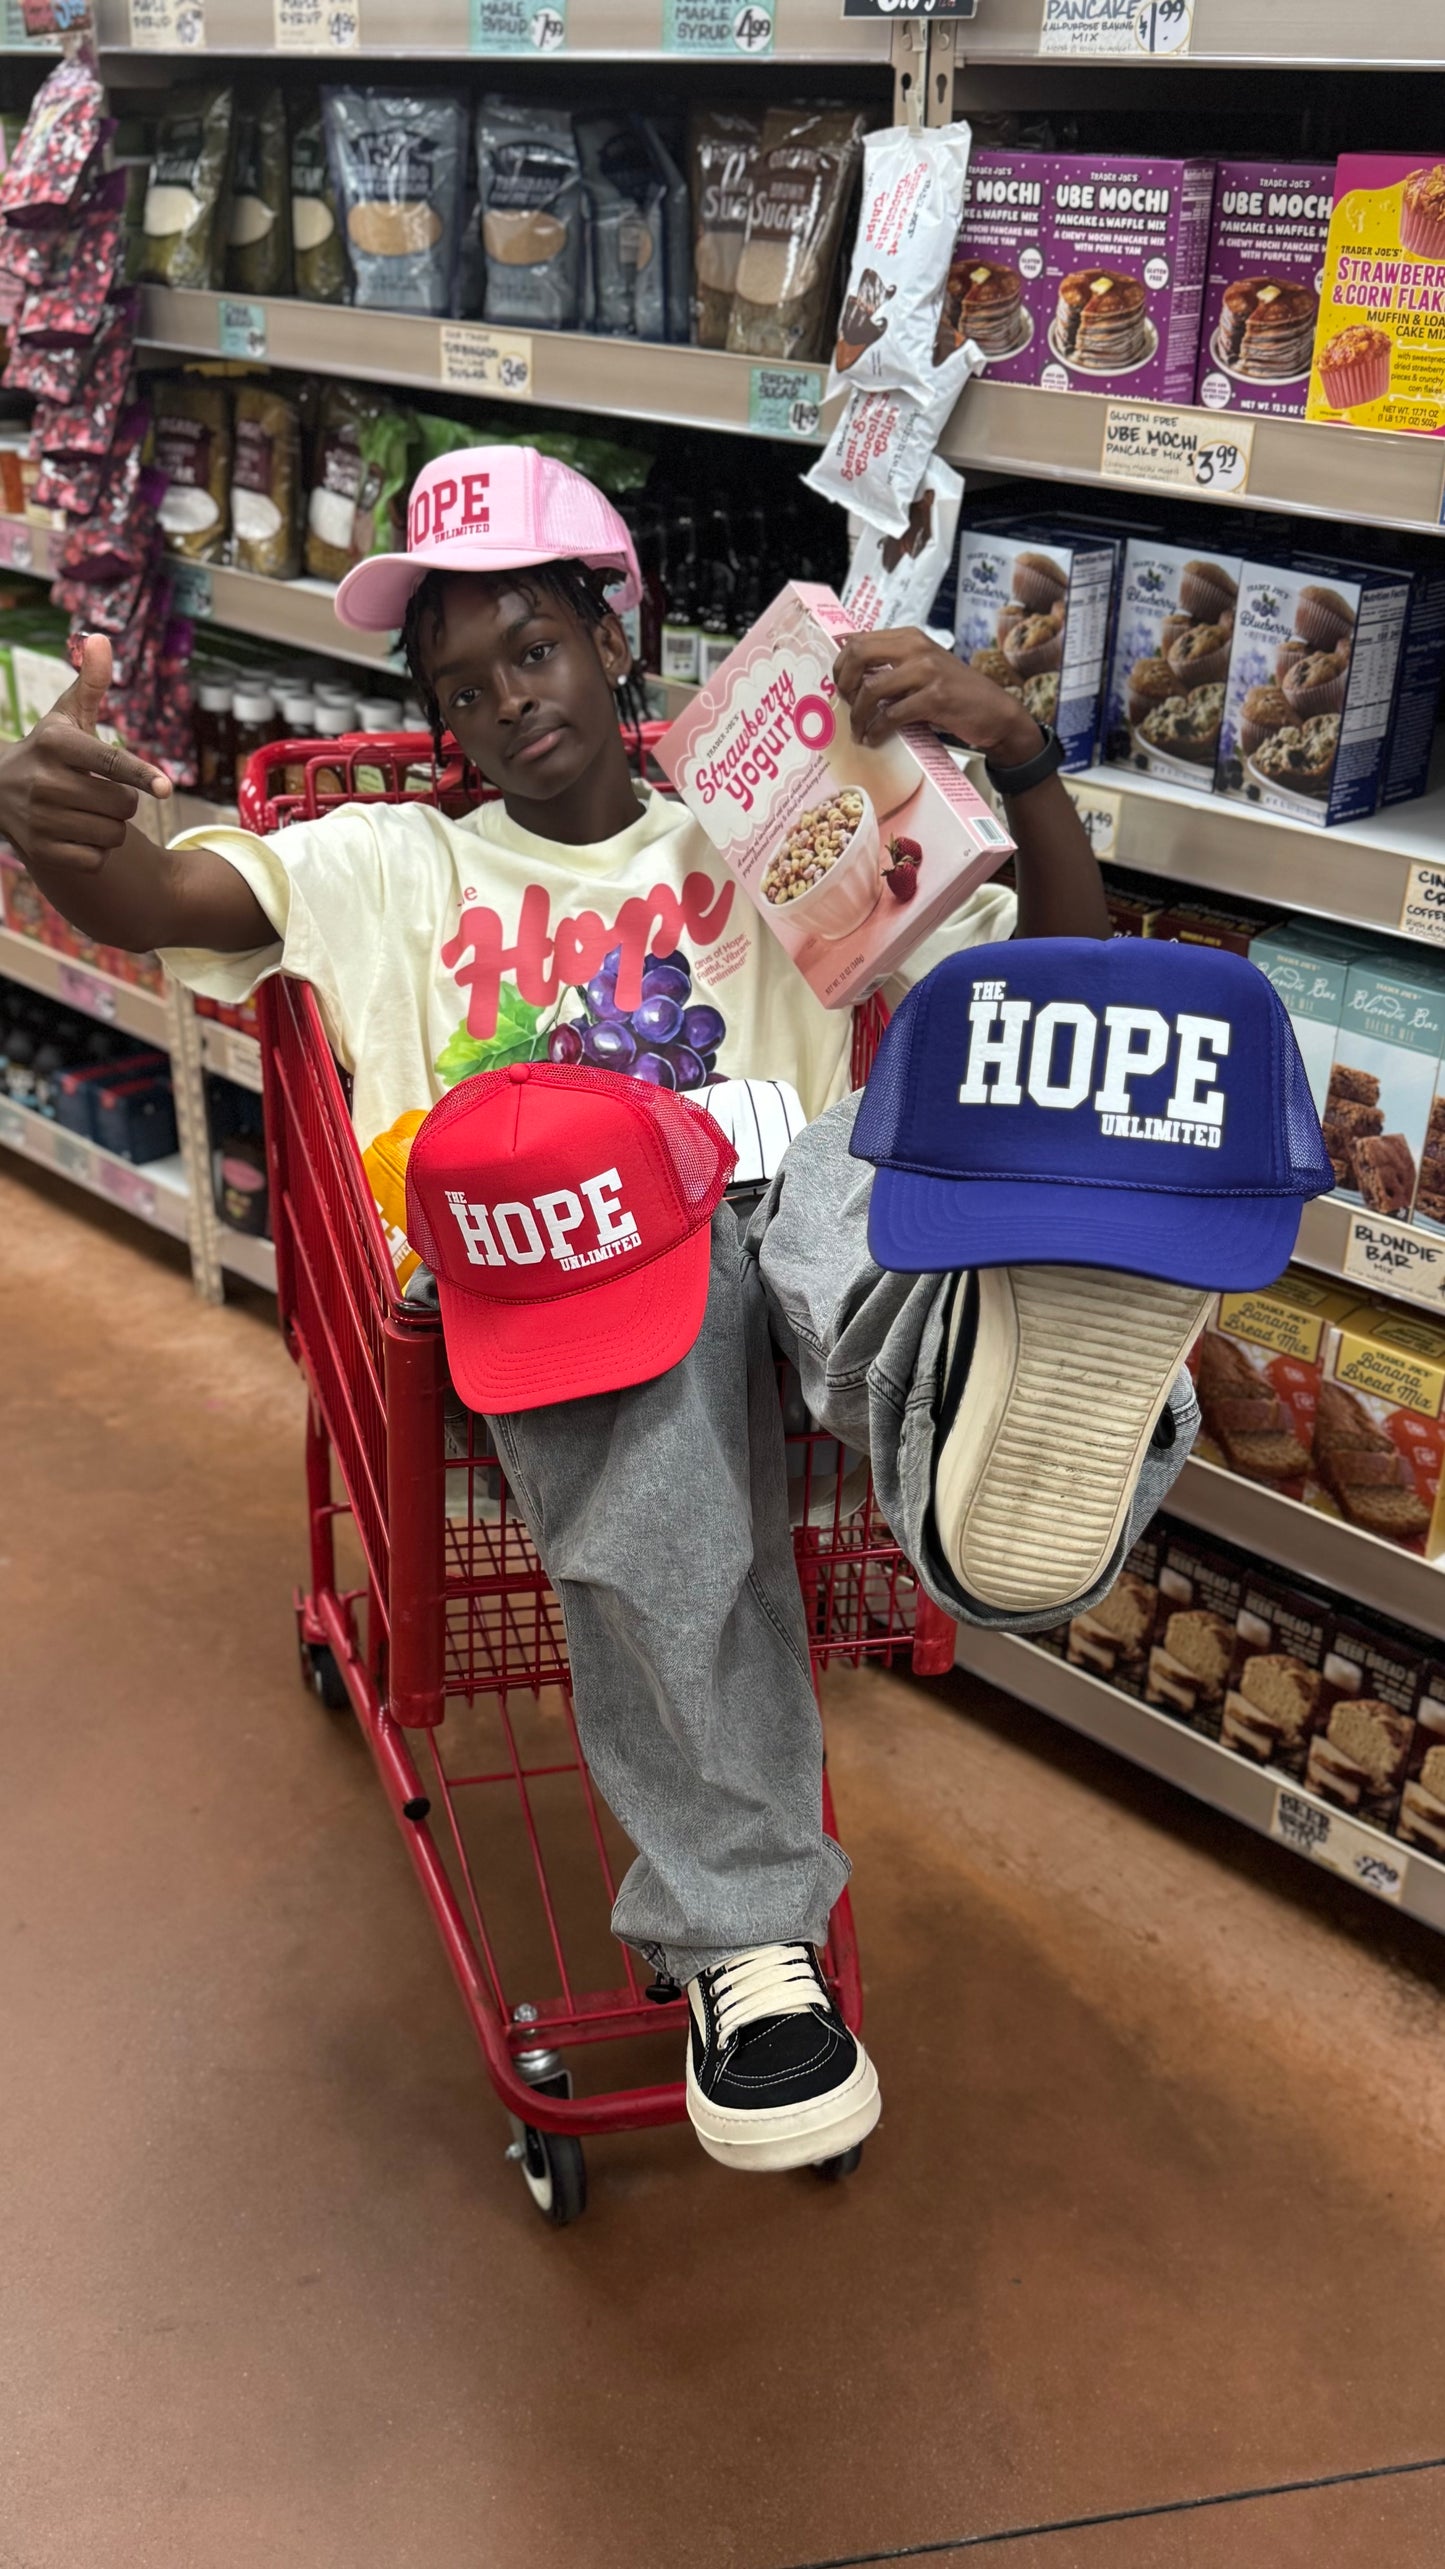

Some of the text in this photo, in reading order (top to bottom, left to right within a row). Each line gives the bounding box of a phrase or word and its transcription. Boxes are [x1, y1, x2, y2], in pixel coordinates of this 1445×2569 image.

[481, 1, 524, 17] MAPLE
[675, 7, 730, 20] MAPLE
[1047, 0, 1141, 20] PANCAKE
[482, 17, 528, 35] SYRUP
[677, 22, 731, 39] SYRUP
[1101, 22, 1133, 30] BAKING
[1072, 33, 1099, 42] MIX
[1091, 172, 1116, 181] TRADER
[1260, 178, 1287, 188] TRADER
[977, 180, 1040, 205] MOCHI
[1056, 184, 1169, 213] UBE MOCHI
[1222, 191, 1263, 215] UBE
[983, 209, 1019, 221] WAFFLE
[1021, 211, 1039, 222] MIX
[1055, 213, 1098, 227] PANCAKE
[1106, 217, 1144, 230] WAFFLE
[1147, 219, 1167, 231] MIX
[1053, 230, 1166, 246] A CHEWY MOCHI PANCAKE MIX
[1220, 221, 1266, 234] PANCAKE
[1275, 224, 1316, 237] WAFFLE
[1074, 242, 1142, 255] WITH PURPLE YAM
[1218, 238, 1320, 253] A CHEWY MOCHI PANCAKE
[1341, 245, 1399, 257] TRADER JOE'S
[1240, 250, 1312, 263] WITH PURPLE YAM
[1333, 283, 1445, 312] & CORN FLAK
[1366, 310, 1410, 324] MUFFIN
[1412, 314, 1421, 325] &
[1396, 325, 1425, 338] CAKE
[1398, 352, 1410, 360] with
[1394, 362, 1445, 376] dried strawberry
[1391, 373, 1411, 381] pieces
[1418, 376, 1443, 386] crunchy
[1241, 400, 1256, 409] NET
[1383, 405, 1396, 413] NET
[1428, 410, 1439, 418] OZ
[1110, 410, 1179, 427] GLUTEN FREE
[1107, 426, 1198, 451] UBE MOCHI
[1106, 443, 1182, 460] PANCAKE MIX
[434, 523, 490, 544] UNLIMITED
[1126, 586, 1177, 615] Blueberry
[1240, 610, 1292, 642] Blueberry
[695, 669, 796, 804] Strawberry
[706, 714, 740, 759] TRADER JOE'S
[441, 871, 736, 1040] Hope
[972, 981, 1006, 1001] THE
[1348, 989, 1439, 1032] Blondie Bar
[959, 1000, 1231, 1126] HOPE
[1101, 1113, 1221, 1149] UNLIMITED
[444, 1190, 467, 1204] THE
[449, 1167, 638, 1267] HOPE
[559, 1232, 642, 1272] UNLIMITED
[1355, 1225, 1444, 1262] BLONDIE
[1366, 1245, 1413, 1269] BAR
[1374, 1263, 1394, 1275] MIX
[1238, 1301, 1300, 1335] Banana
[1223, 1313, 1310, 1355] Bread Mix
[1357, 1351, 1422, 1388] Banana
[1342, 1363, 1432, 1410] Bread Mix
